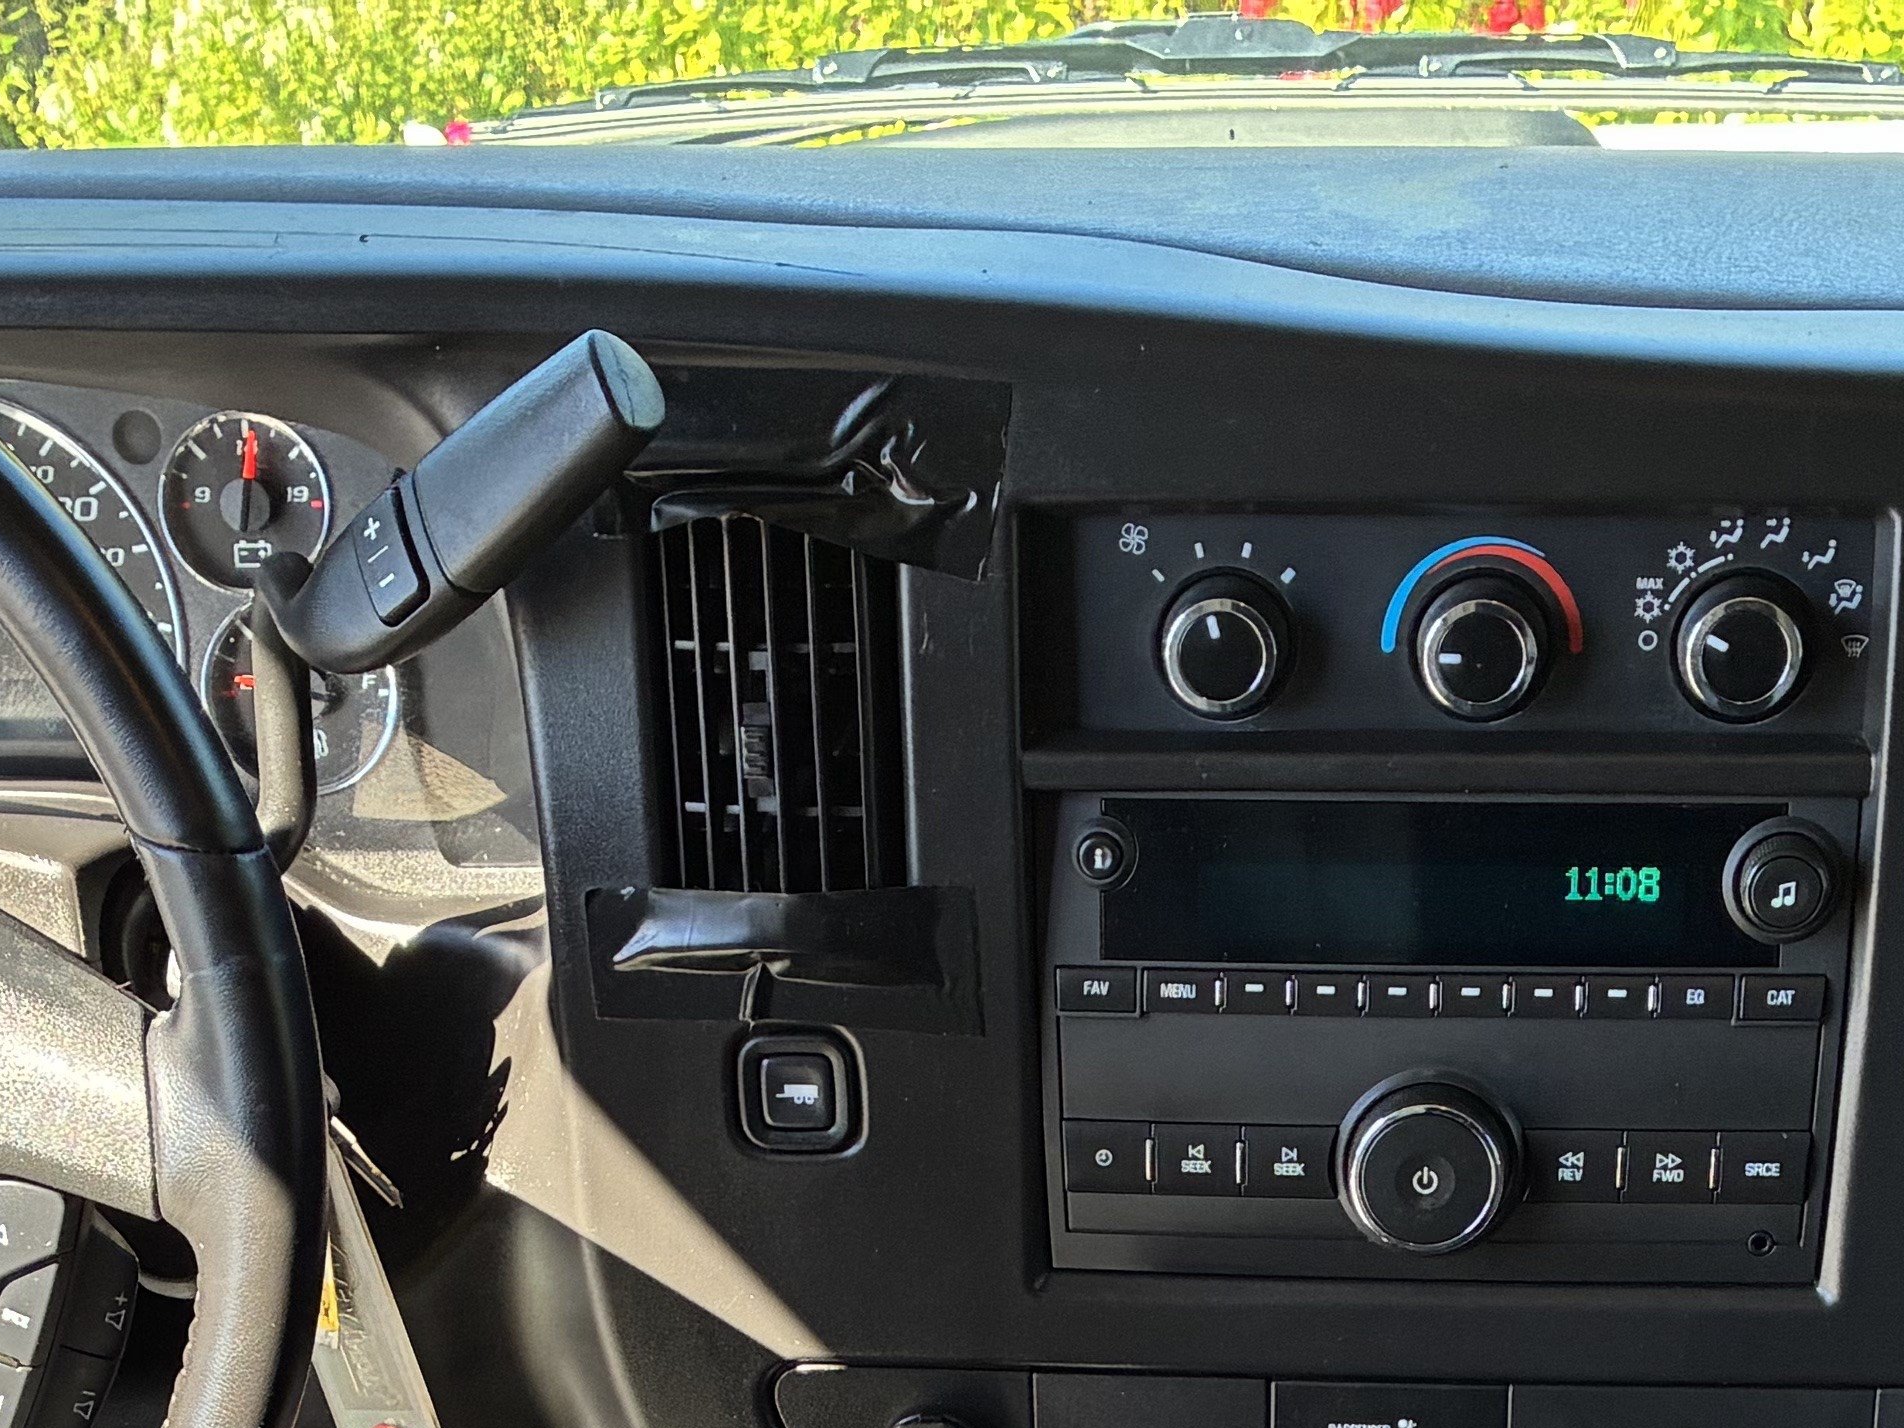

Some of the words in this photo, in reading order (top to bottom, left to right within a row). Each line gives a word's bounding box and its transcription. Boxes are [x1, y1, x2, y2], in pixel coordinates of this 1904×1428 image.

[194, 486, 211, 504] 9
[287, 485, 309, 503] 19
[1636, 577, 1664, 590] MAX
[362, 673, 377, 690] F
[1564, 866, 1661, 902] 11:08
[1083, 980, 1110, 996] FAV
[1159, 982, 1196, 999] MENU
[1685, 988, 1706, 1005] EQ
[1766, 989, 1796, 1006] CAT
[1181, 1160, 1212, 1174] SEEK
[1273, 1162, 1305, 1176] SEEK
[1557, 1168, 1584, 1182] REV
[1745, 1162, 1781, 1177] SRCE
[1652, 1169, 1685, 1183] FWD
